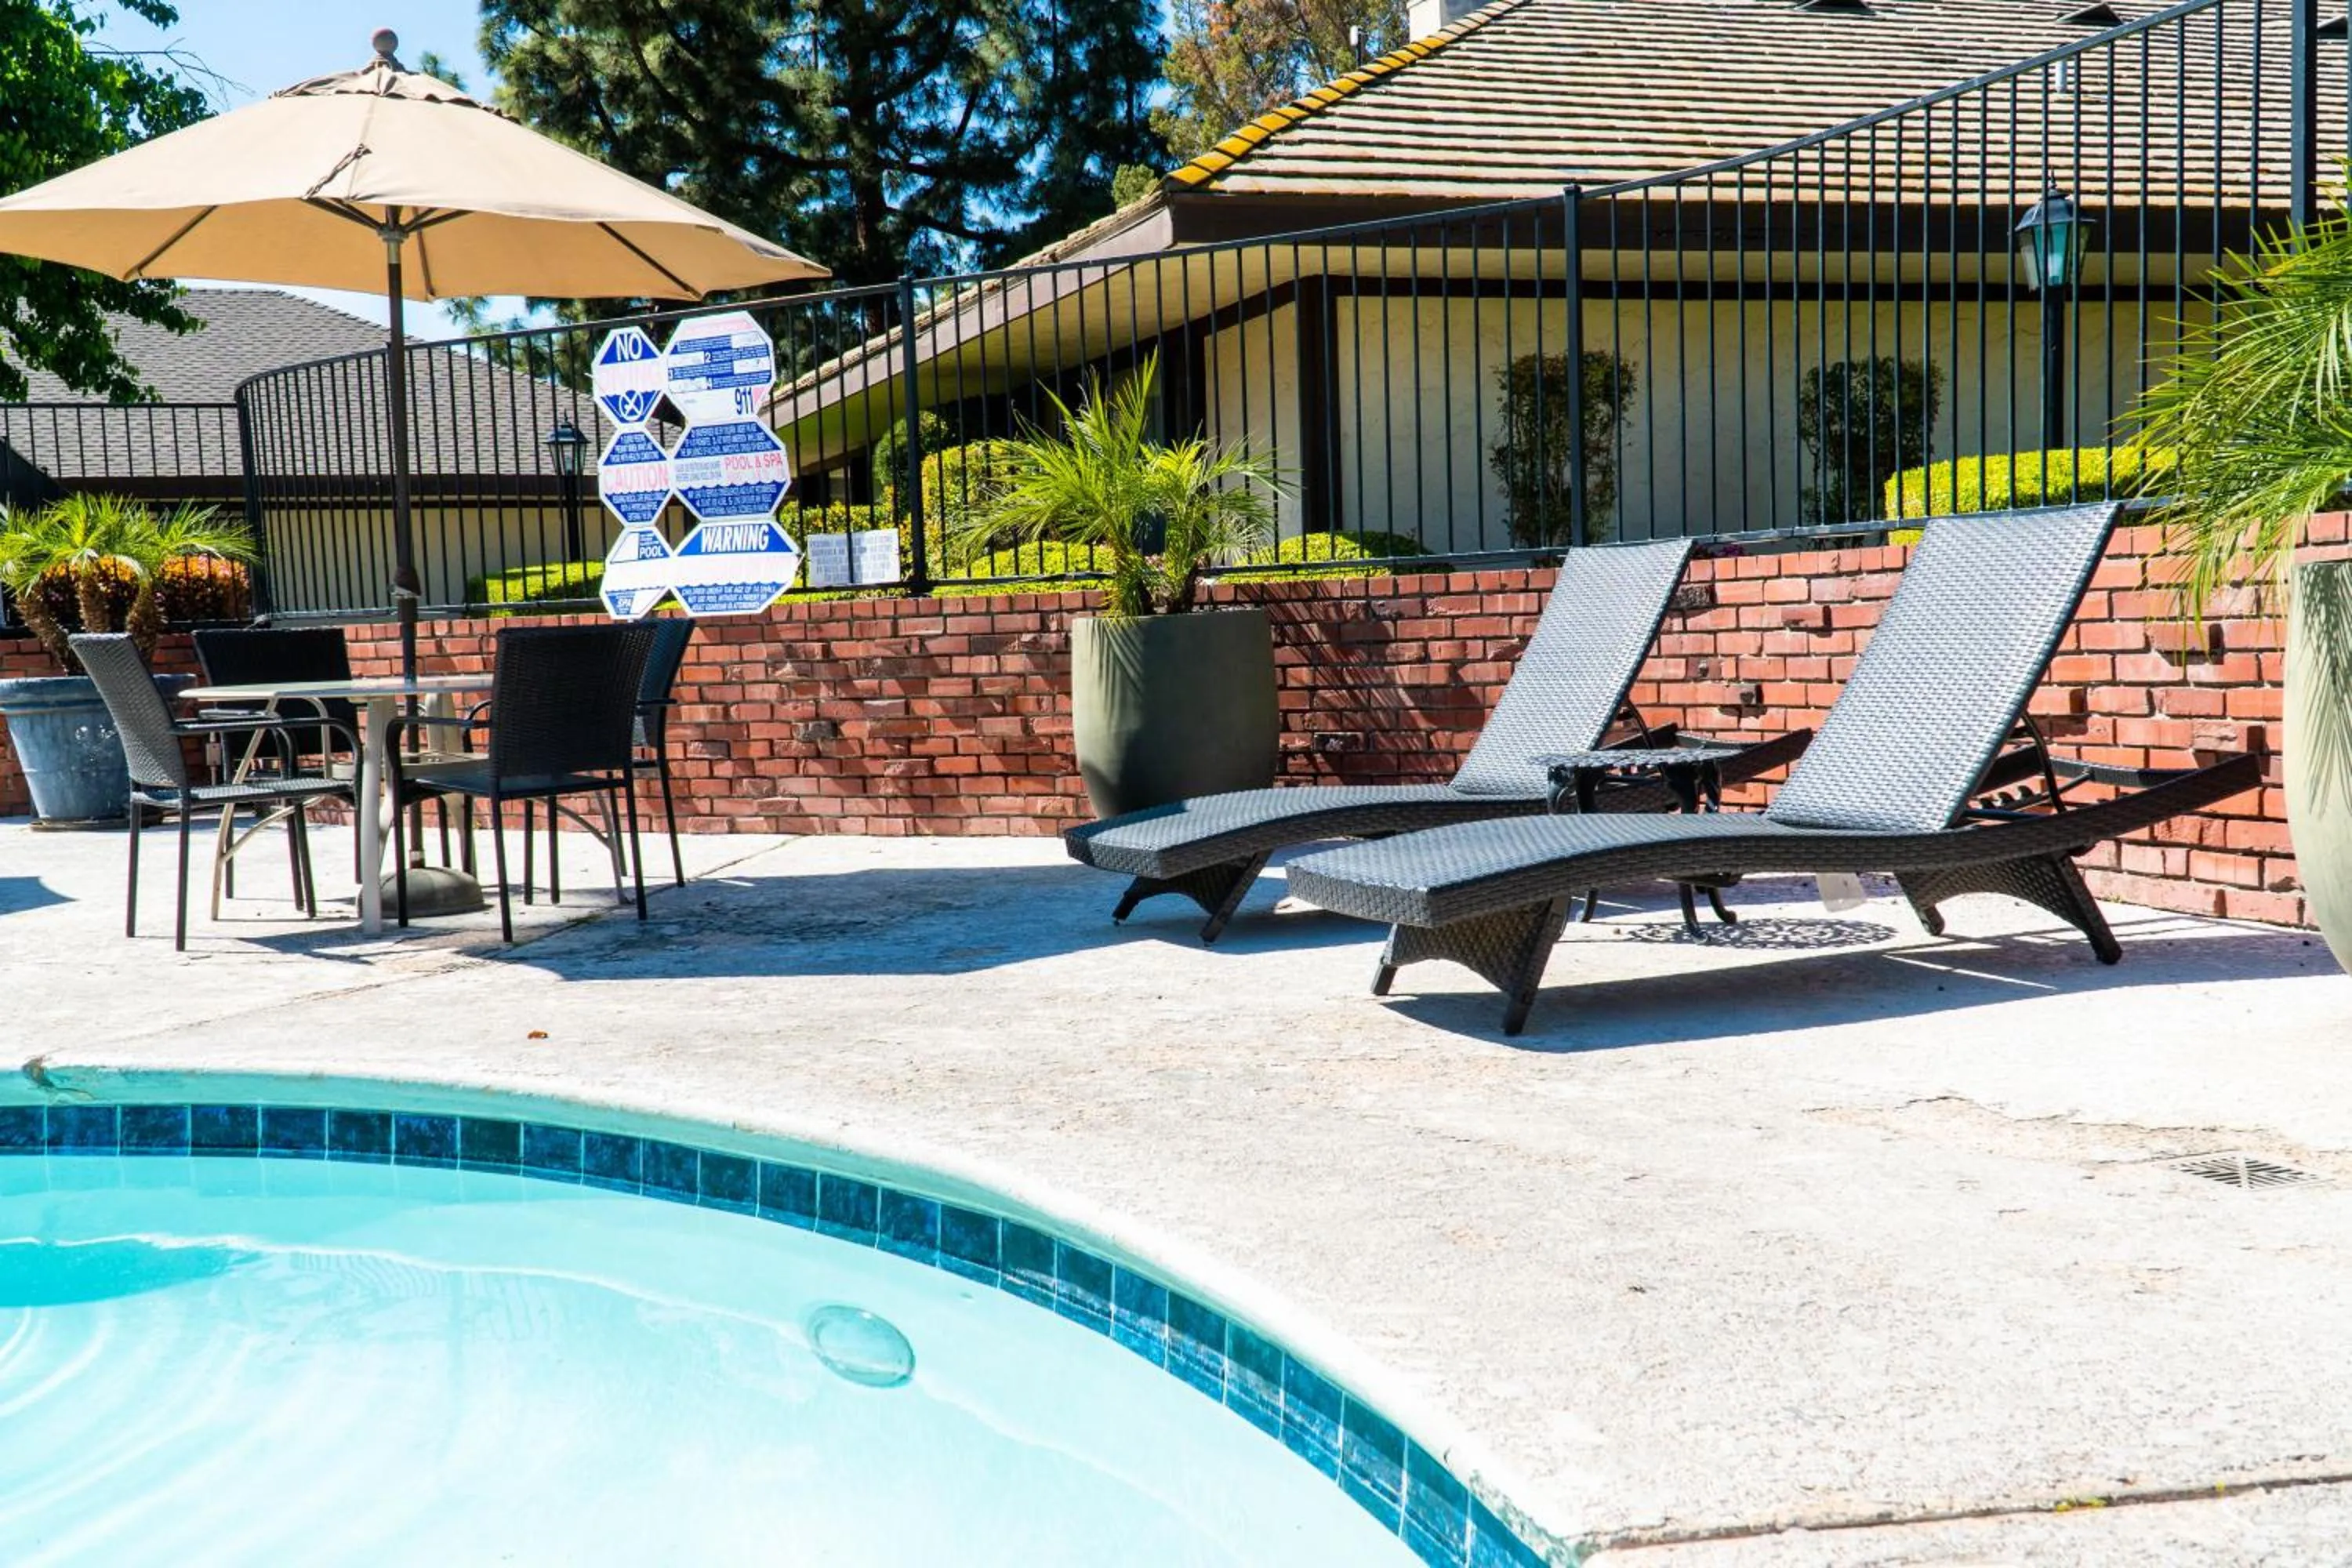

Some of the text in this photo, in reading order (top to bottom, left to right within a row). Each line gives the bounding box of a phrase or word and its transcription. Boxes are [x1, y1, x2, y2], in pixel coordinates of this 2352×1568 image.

[615, 332, 643, 361] NO
[705, 352, 712, 363] 2
[735, 387, 753, 415] 911
[724, 455, 753, 470] POOL
[755, 452, 761, 468] &
[764, 451, 782, 468] SPA
[604, 463, 669, 492] CAUTION
[701, 524, 769, 553] WARNING
[639, 545, 664, 558] POOL
[617, 598, 631, 608] SPA
